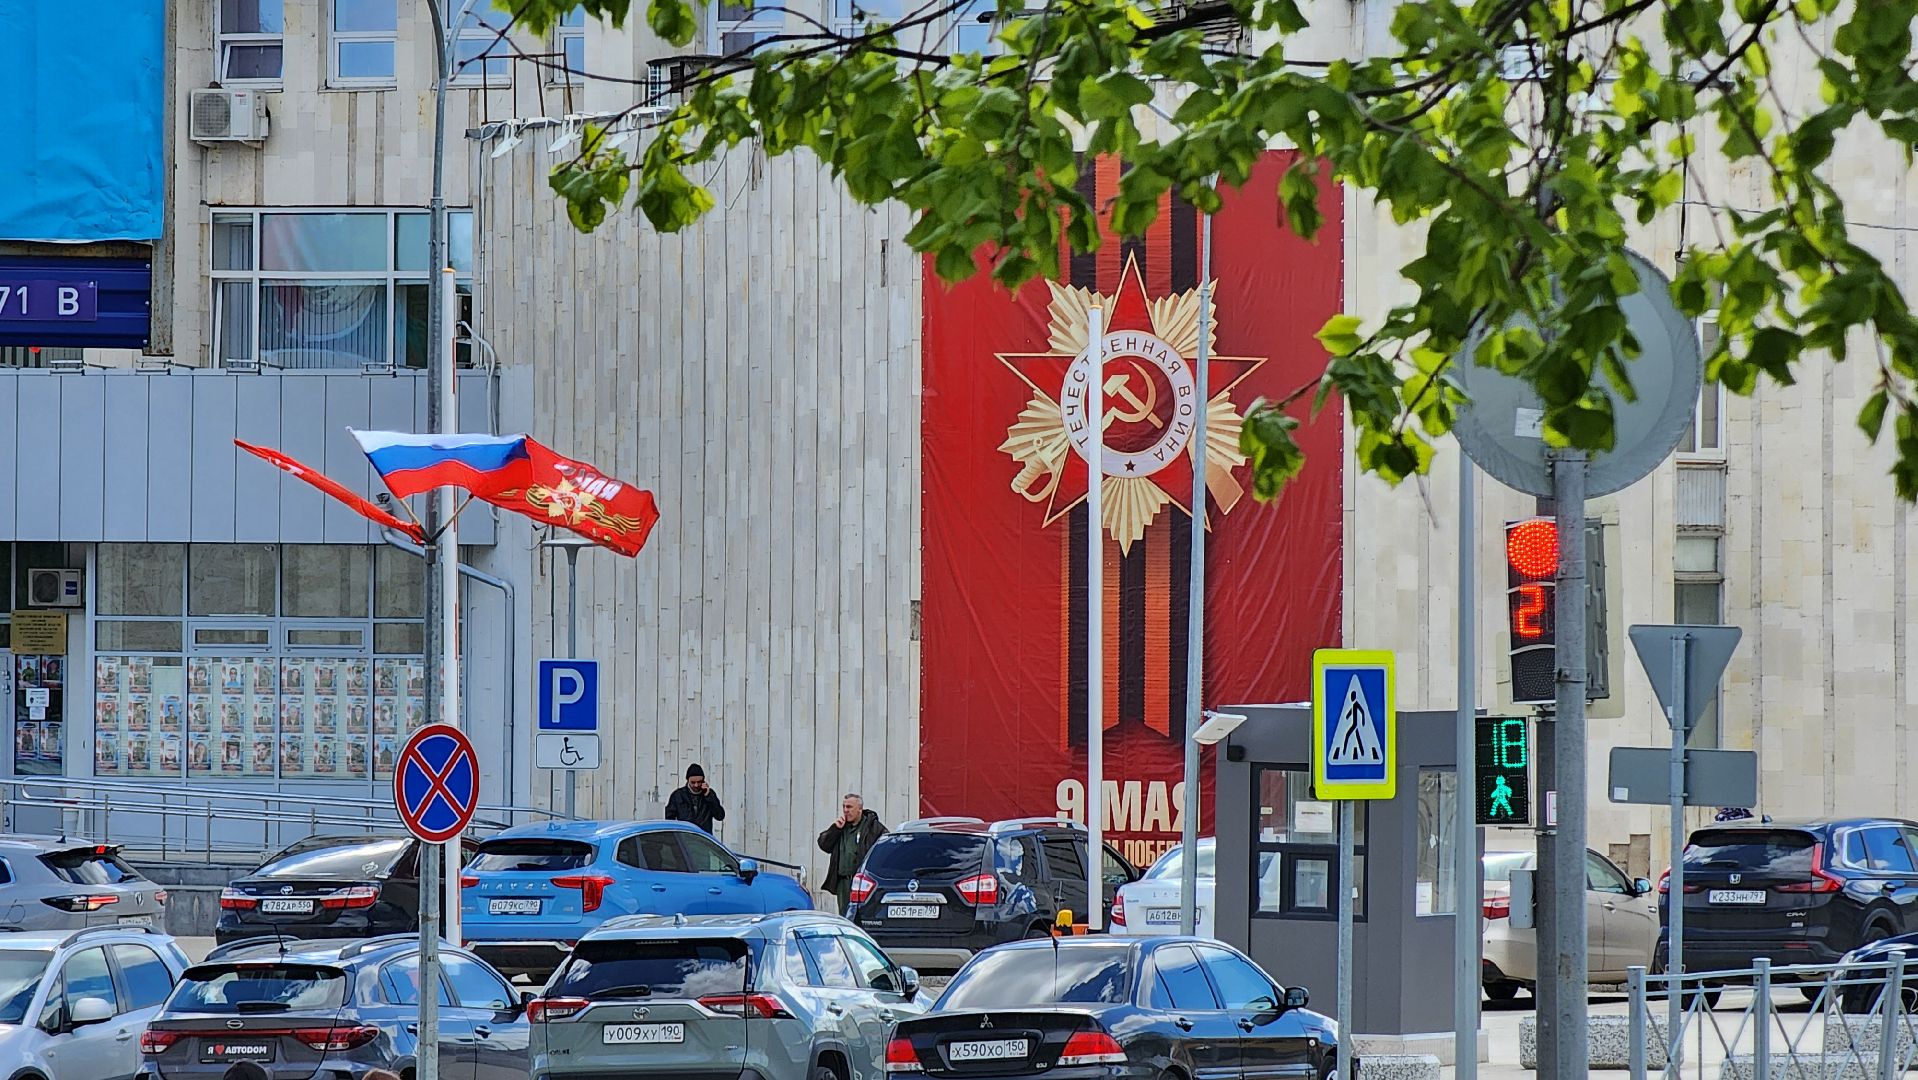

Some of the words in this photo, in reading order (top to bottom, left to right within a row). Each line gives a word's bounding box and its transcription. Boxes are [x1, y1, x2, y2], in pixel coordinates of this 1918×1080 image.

[58, 287, 79, 316] В
[1518, 584, 1543, 635] 2
[551, 667, 585, 724] P
[1492, 719, 1526, 768] 18
[1056, 778, 1085, 829] 9
[491, 900, 524, 910] В079КС
[924, 905, 937, 915] 790
[607, 1026, 658, 1041] У009ХУ
[660, 1025, 680, 1036] 190
[207, 1046, 214, 1054] Я
[954, 1043, 1003, 1058] Х590ХО
[1005, 1040, 1024, 1052] 150
